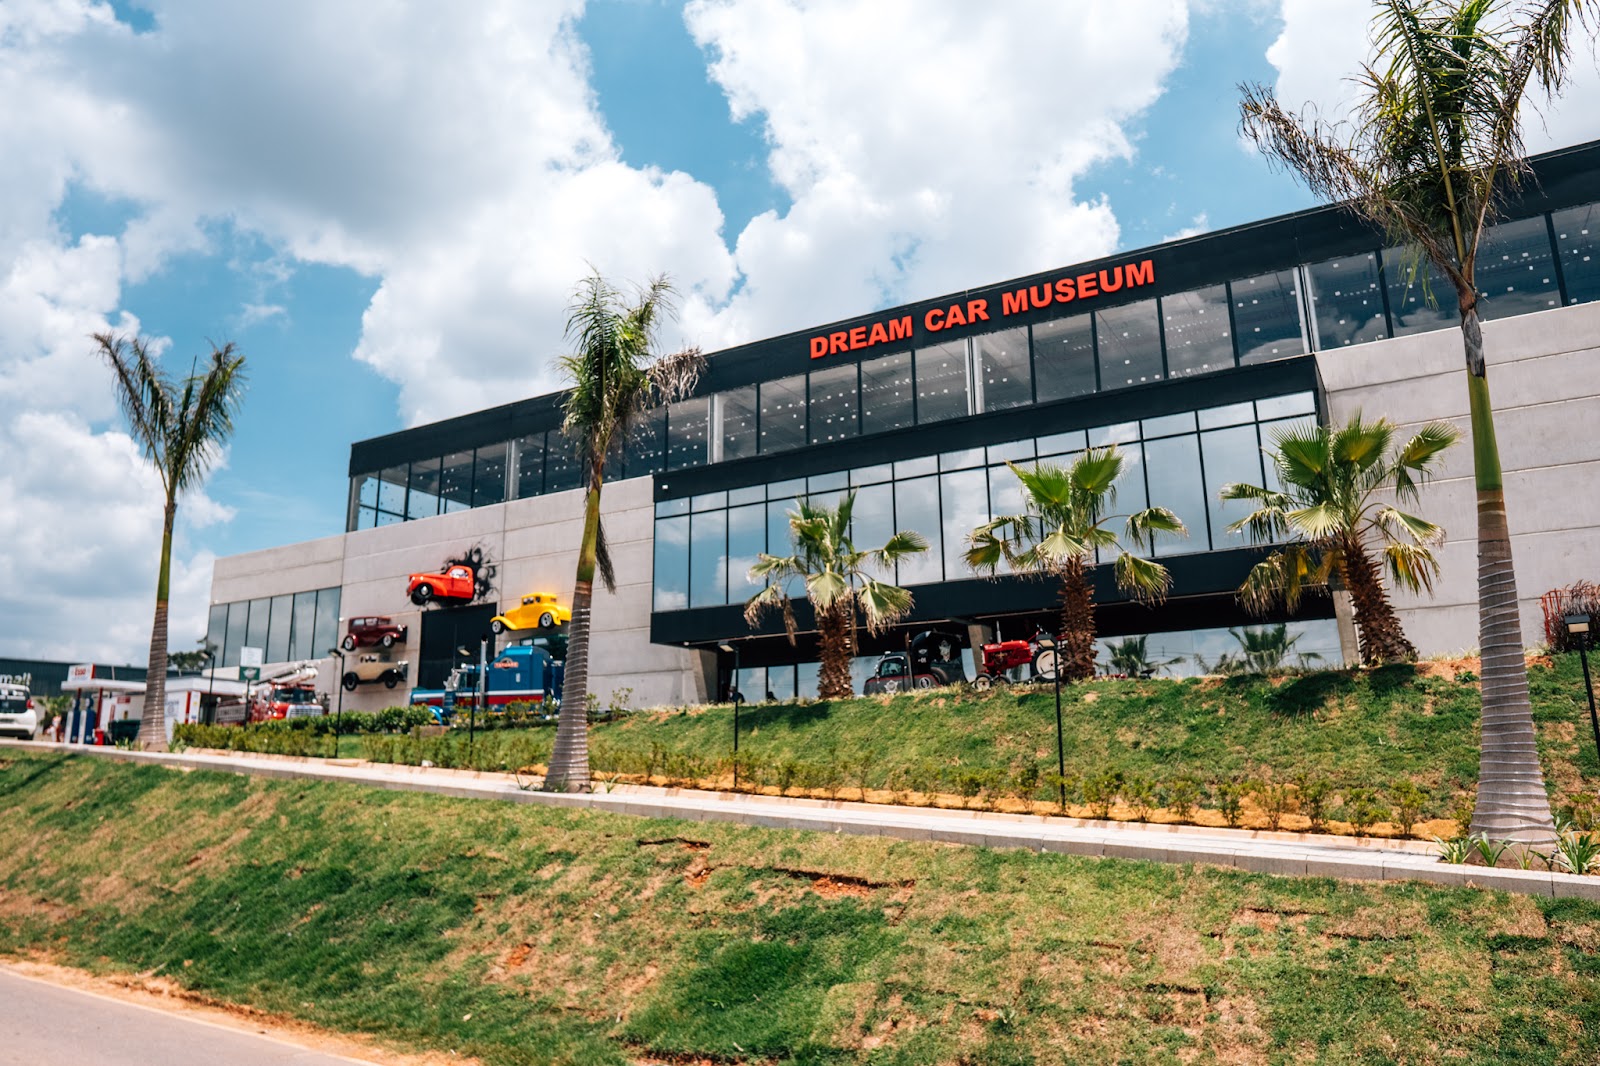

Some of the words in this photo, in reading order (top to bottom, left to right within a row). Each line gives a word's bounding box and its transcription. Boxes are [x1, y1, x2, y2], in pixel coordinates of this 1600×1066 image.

[810, 315, 914, 360] DREAM
[924, 298, 990, 332] CAR
[1001, 259, 1155, 316] MUSEUM
